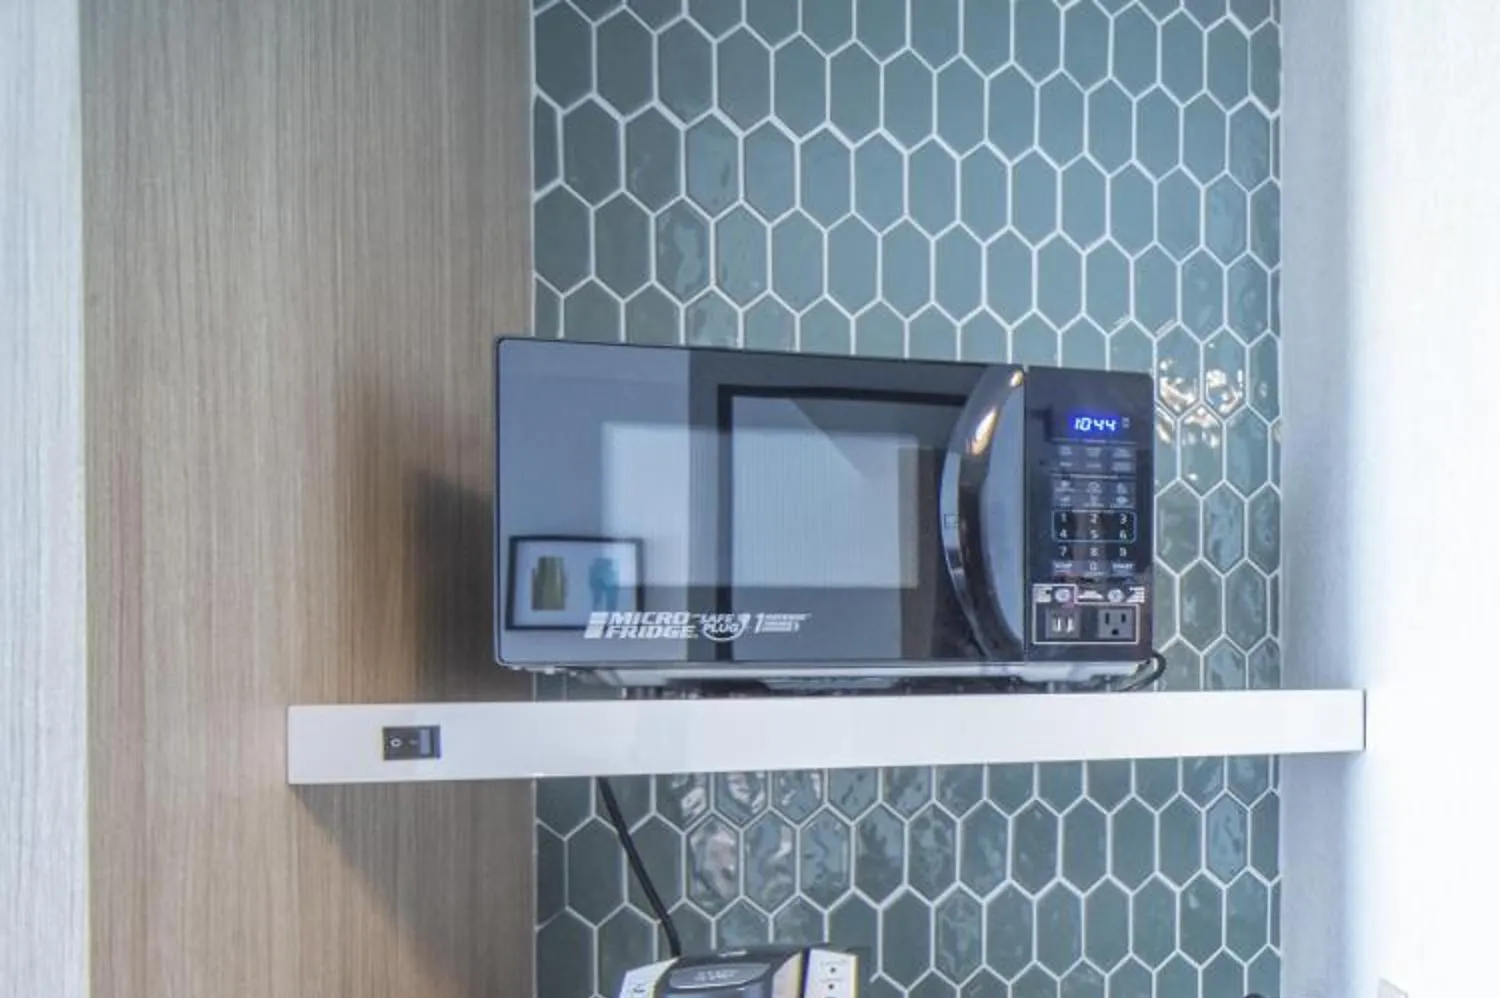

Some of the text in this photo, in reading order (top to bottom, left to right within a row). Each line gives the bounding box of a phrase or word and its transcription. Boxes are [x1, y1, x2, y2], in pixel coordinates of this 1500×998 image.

[1089, 513, 1098, 524] 2
[1119, 513, 1127, 525] 3
[1059, 528, 1127, 540] 4 5 6
[1058, 545, 1127, 557] 7 8 9
[608, 611, 691, 625] MICRO
[700, 613, 736, 624] SAFE
[604, 625, 698, 639] FRIDGE
[703, 623, 740, 633] PLUG
